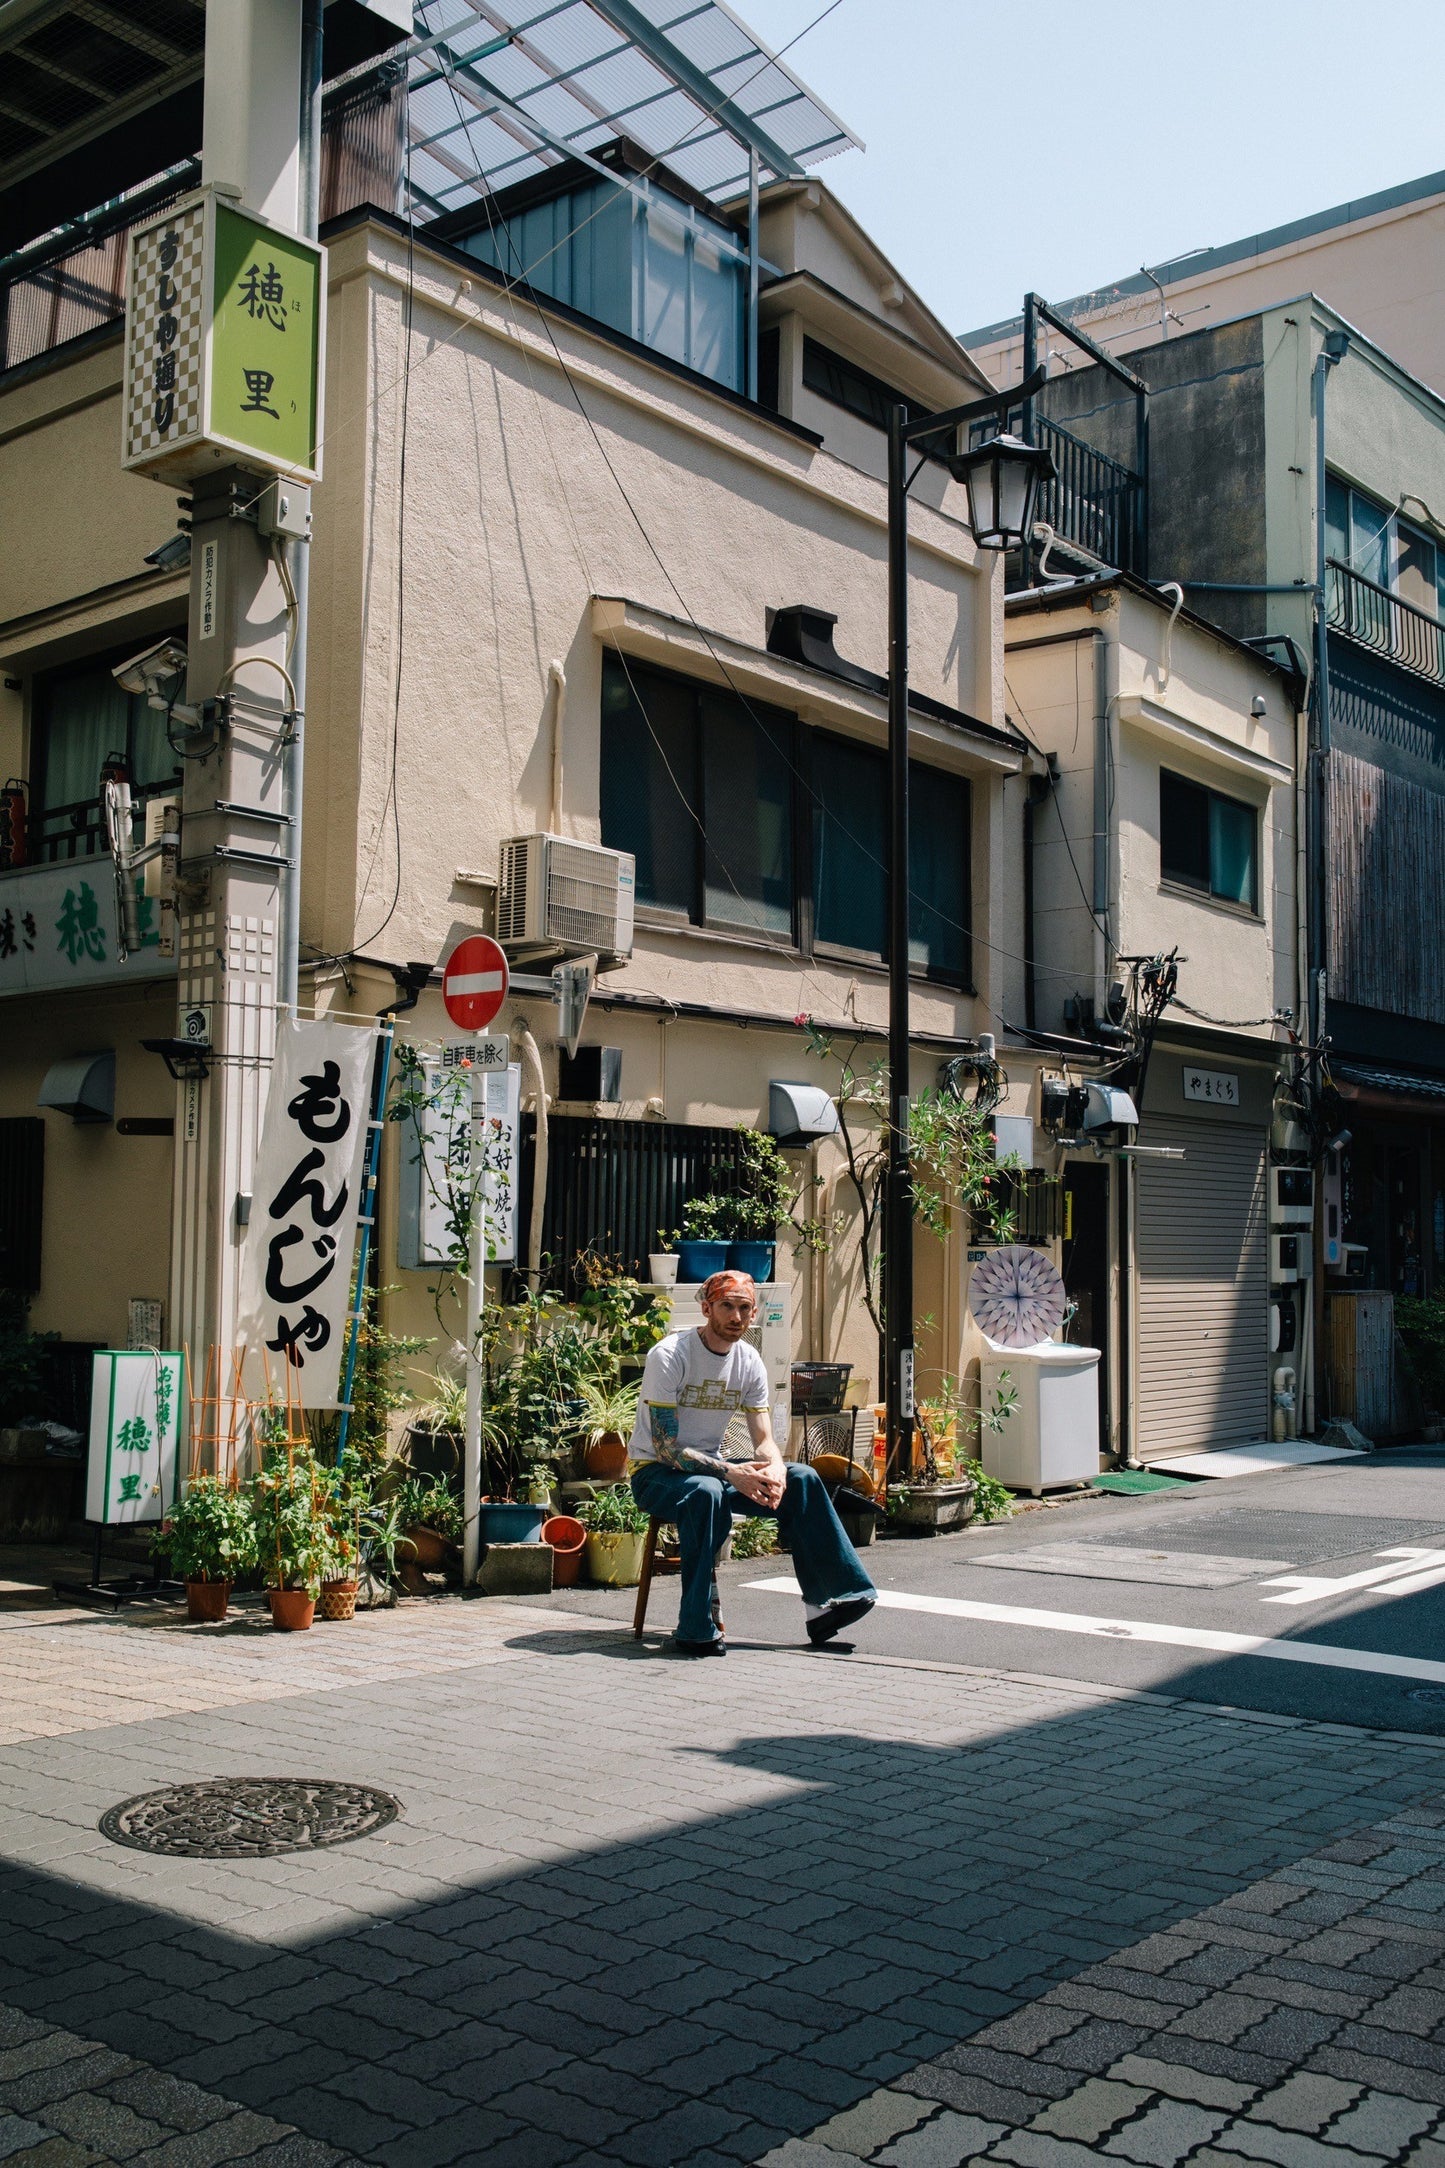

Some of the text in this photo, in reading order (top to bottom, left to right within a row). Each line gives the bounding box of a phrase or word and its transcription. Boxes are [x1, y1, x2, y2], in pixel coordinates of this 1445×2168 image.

[155, 231, 181, 434] すしや通り
[237, 262, 286, 420] 穂里
[203, 546, 214, 635] 防犯カメラ作動中
[443, 1043, 503, 1067] 自転車を除く
[1190, 1076, 1234, 1100] やまぐち
[116, 1416, 151, 1504] 穂里
